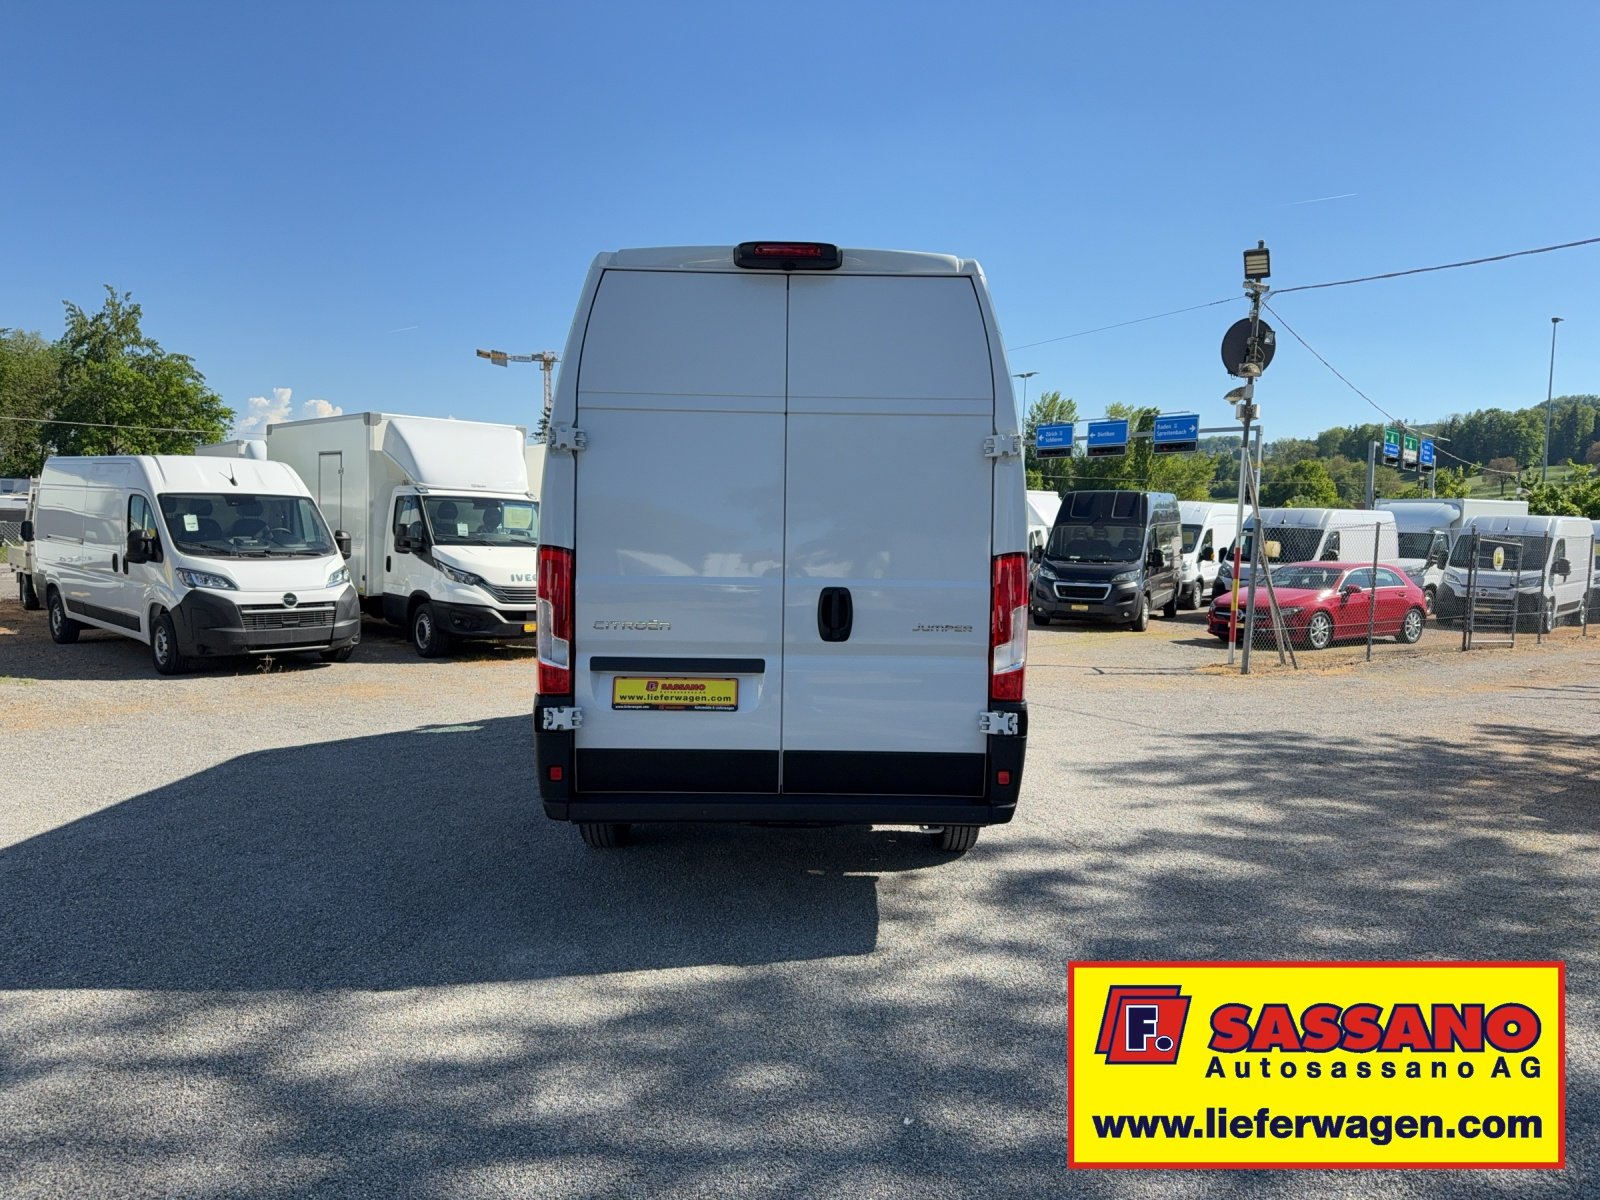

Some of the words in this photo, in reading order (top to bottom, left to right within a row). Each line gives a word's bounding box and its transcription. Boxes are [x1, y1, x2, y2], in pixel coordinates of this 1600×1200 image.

[912, 622, 973, 633] JUMPER
[660, 683, 706, 691] SASSANO
[619, 693, 732, 703] www.lieferwagen.com
